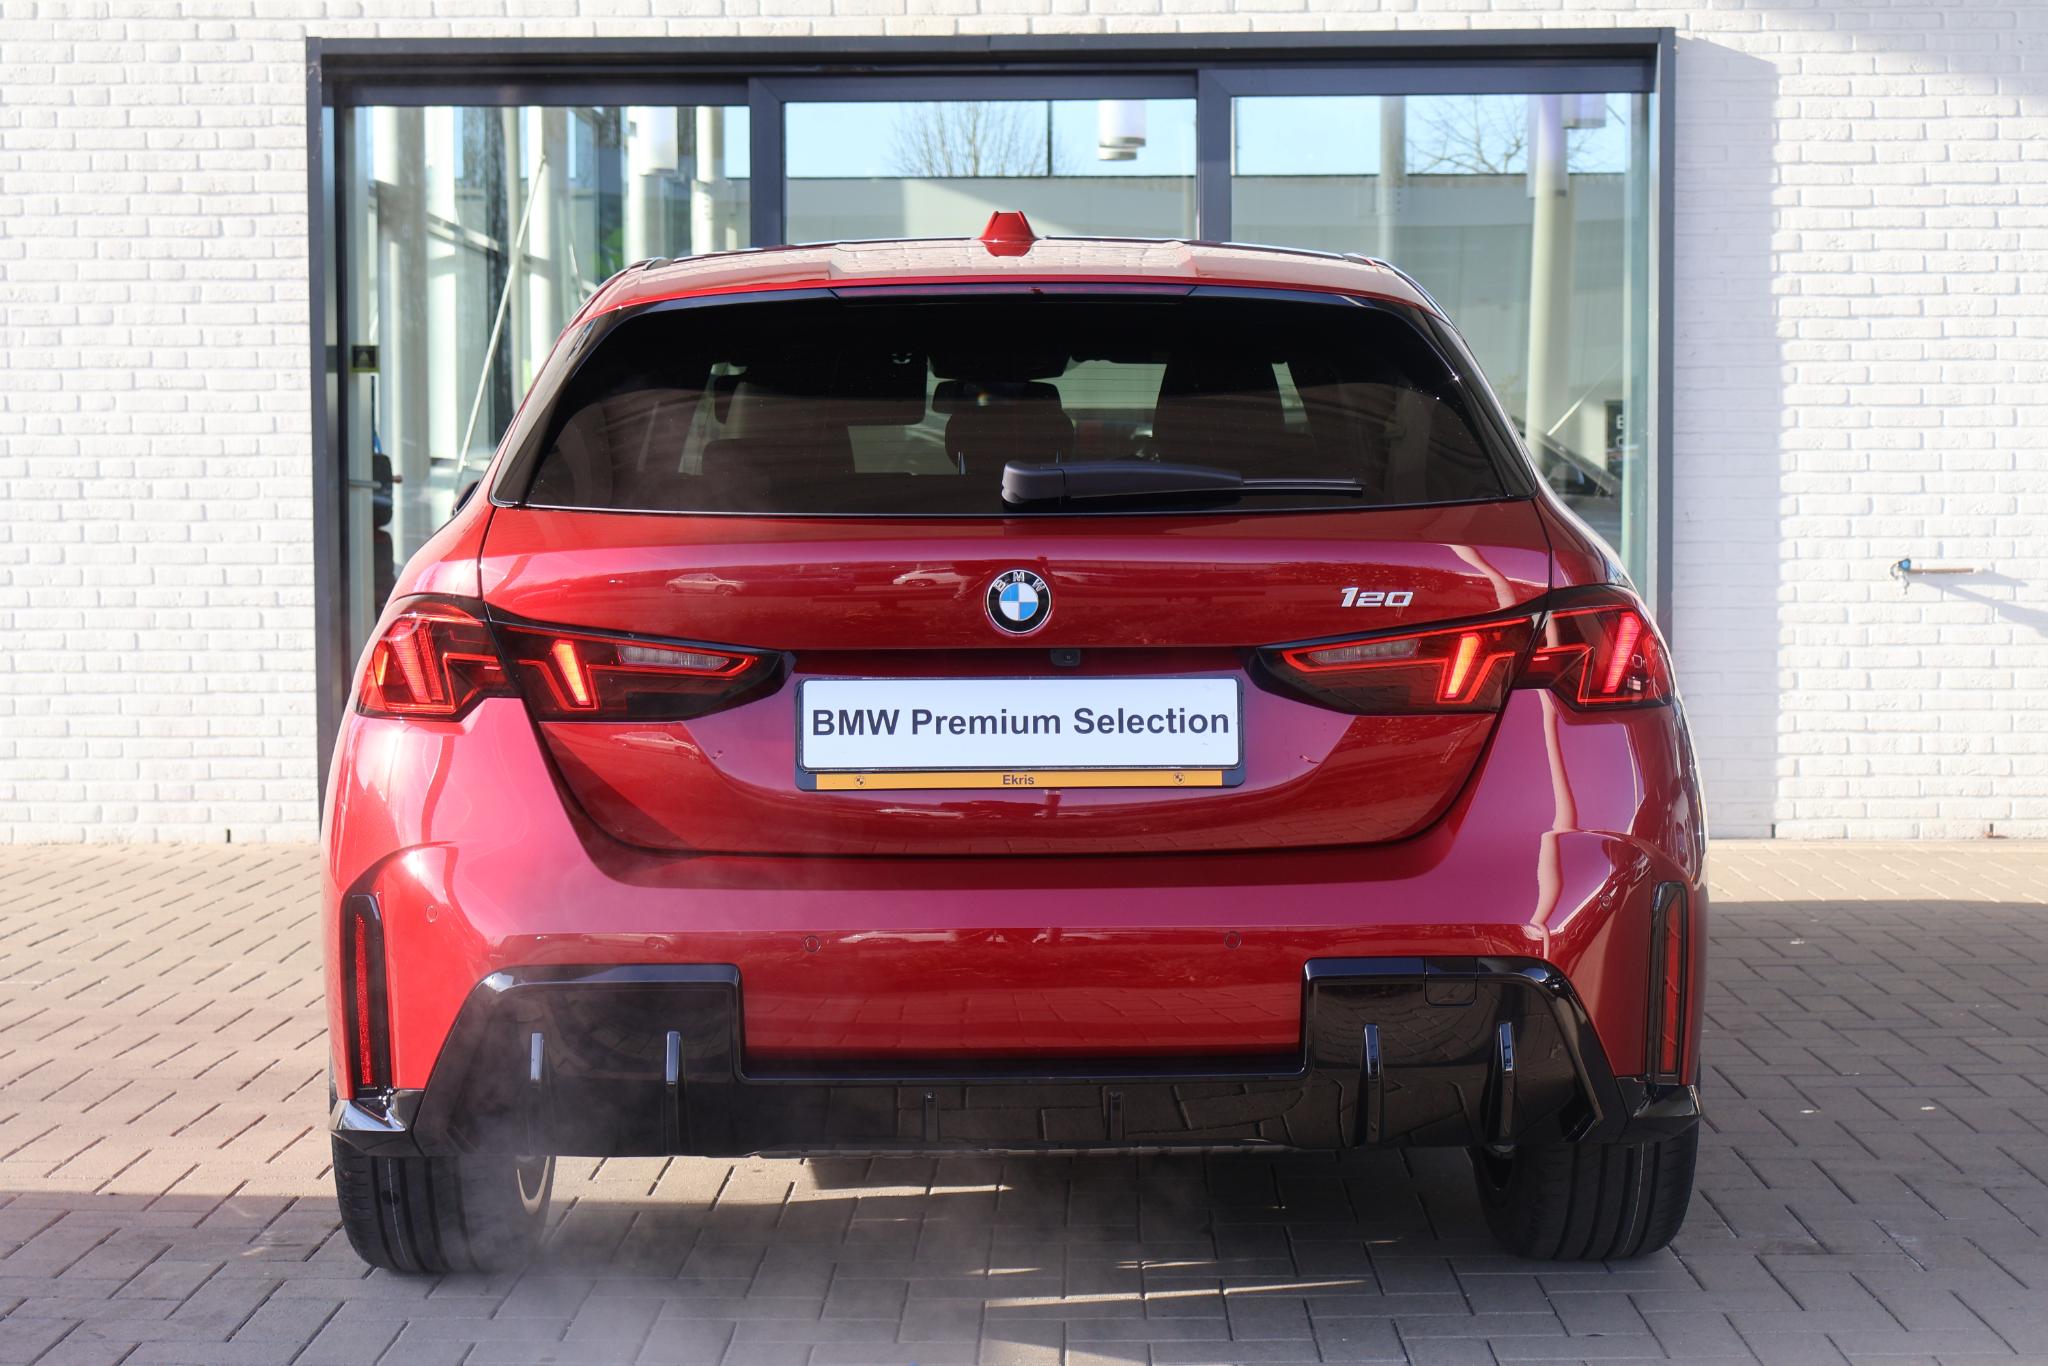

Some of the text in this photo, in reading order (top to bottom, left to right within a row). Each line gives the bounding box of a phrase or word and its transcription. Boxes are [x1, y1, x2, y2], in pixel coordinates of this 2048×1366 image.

[993, 571, 1045, 592] BMW
[1341, 587, 1414, 608] 120
[813, 707, 1230, 736] BMW Premium Selection
[1002, 774, 1035, 785] Ekris
